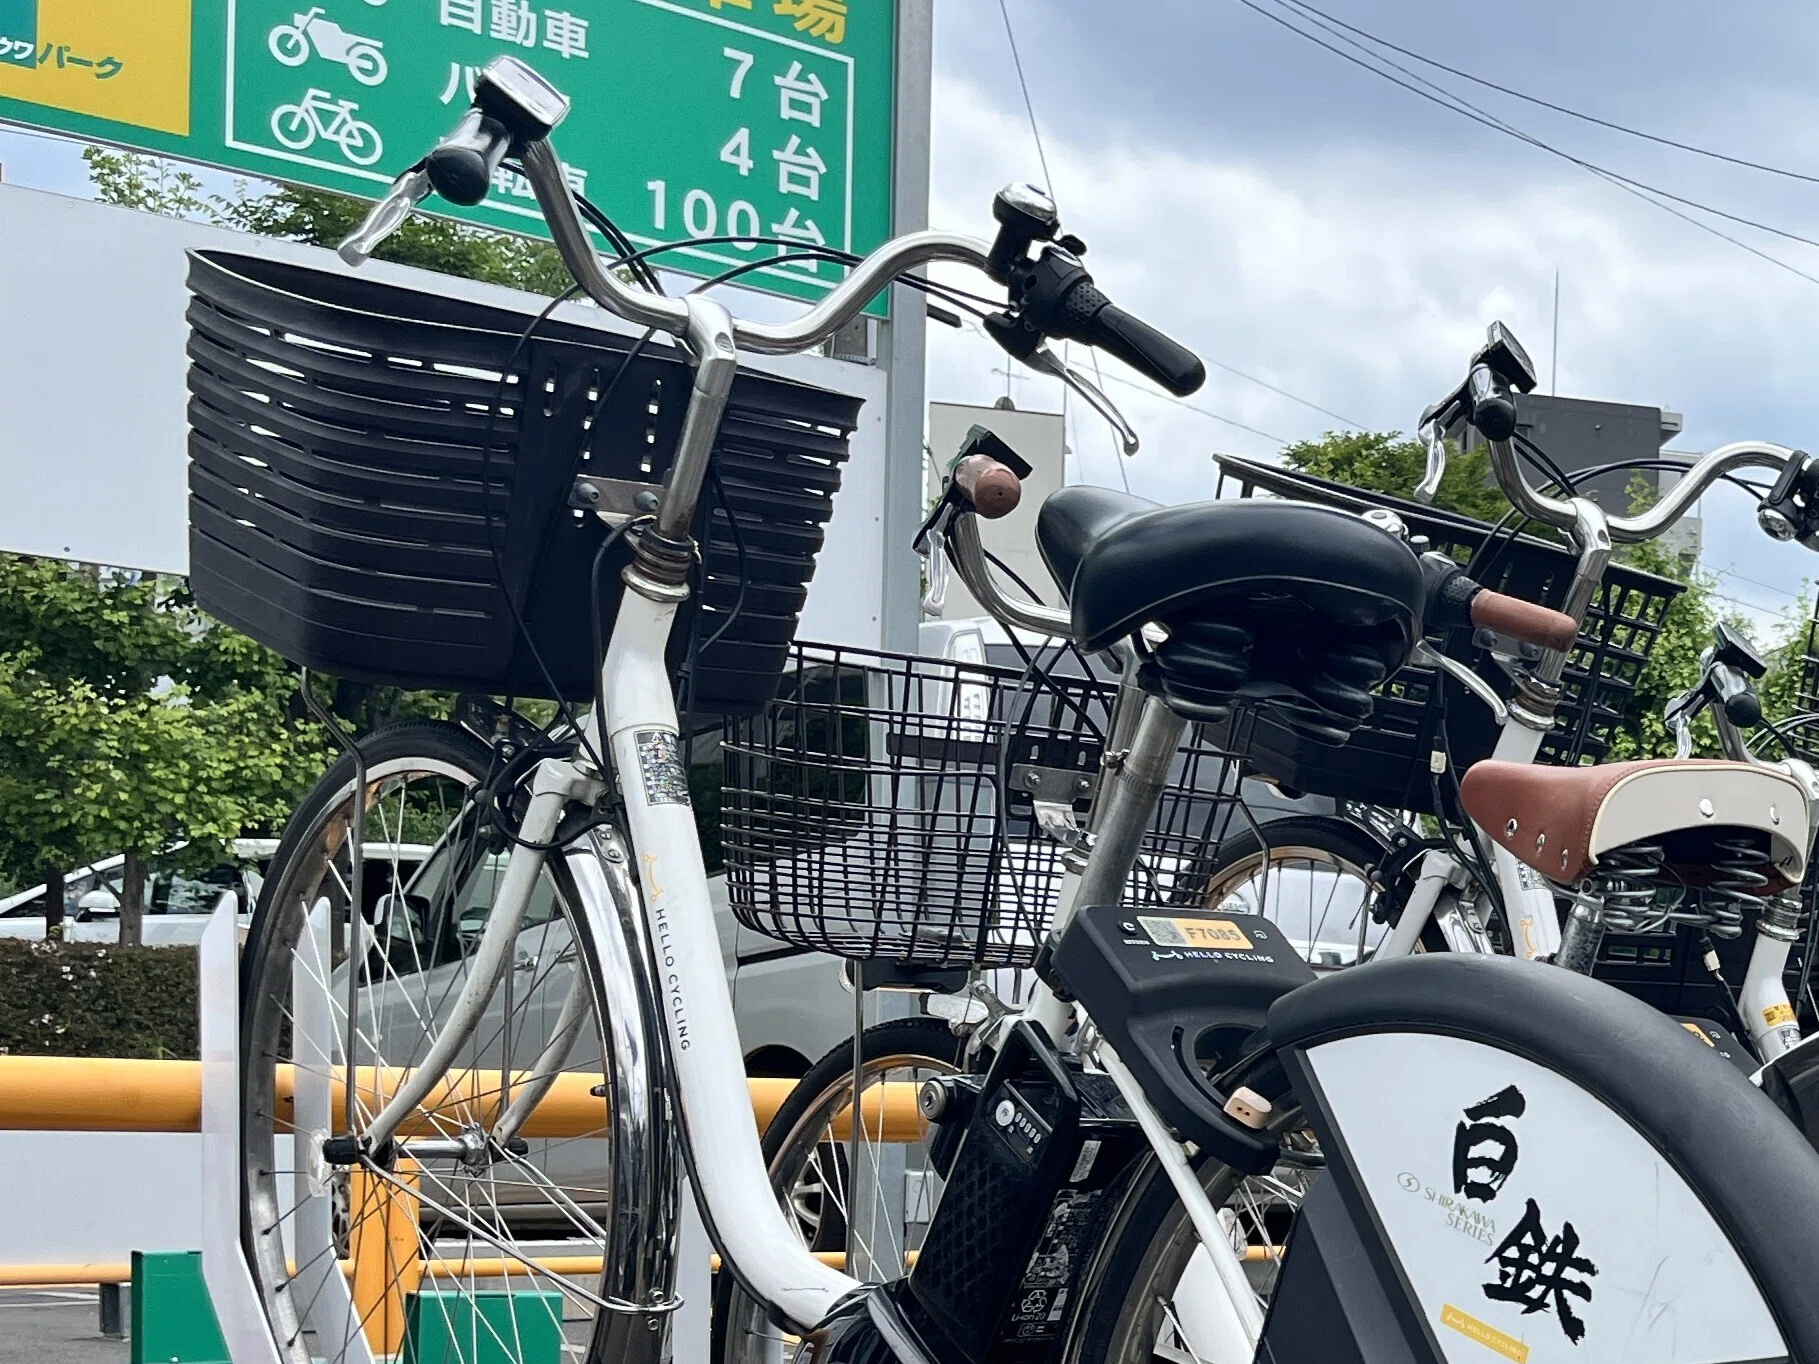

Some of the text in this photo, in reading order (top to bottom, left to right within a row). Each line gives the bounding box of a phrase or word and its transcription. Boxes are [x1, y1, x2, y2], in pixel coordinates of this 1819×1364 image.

[439, 0, 590, 59] 自動車
[1184, 927, 1242, 941] F7085
[1183, 951, 1275, 963] HELLO CYCLING
[655, 908, 691, 1051] HELLO CYCLING
[1423, 1186, 1496, 1233] SHIRAKAWA
[1446, 1213, 1495, 1247] SERIES
